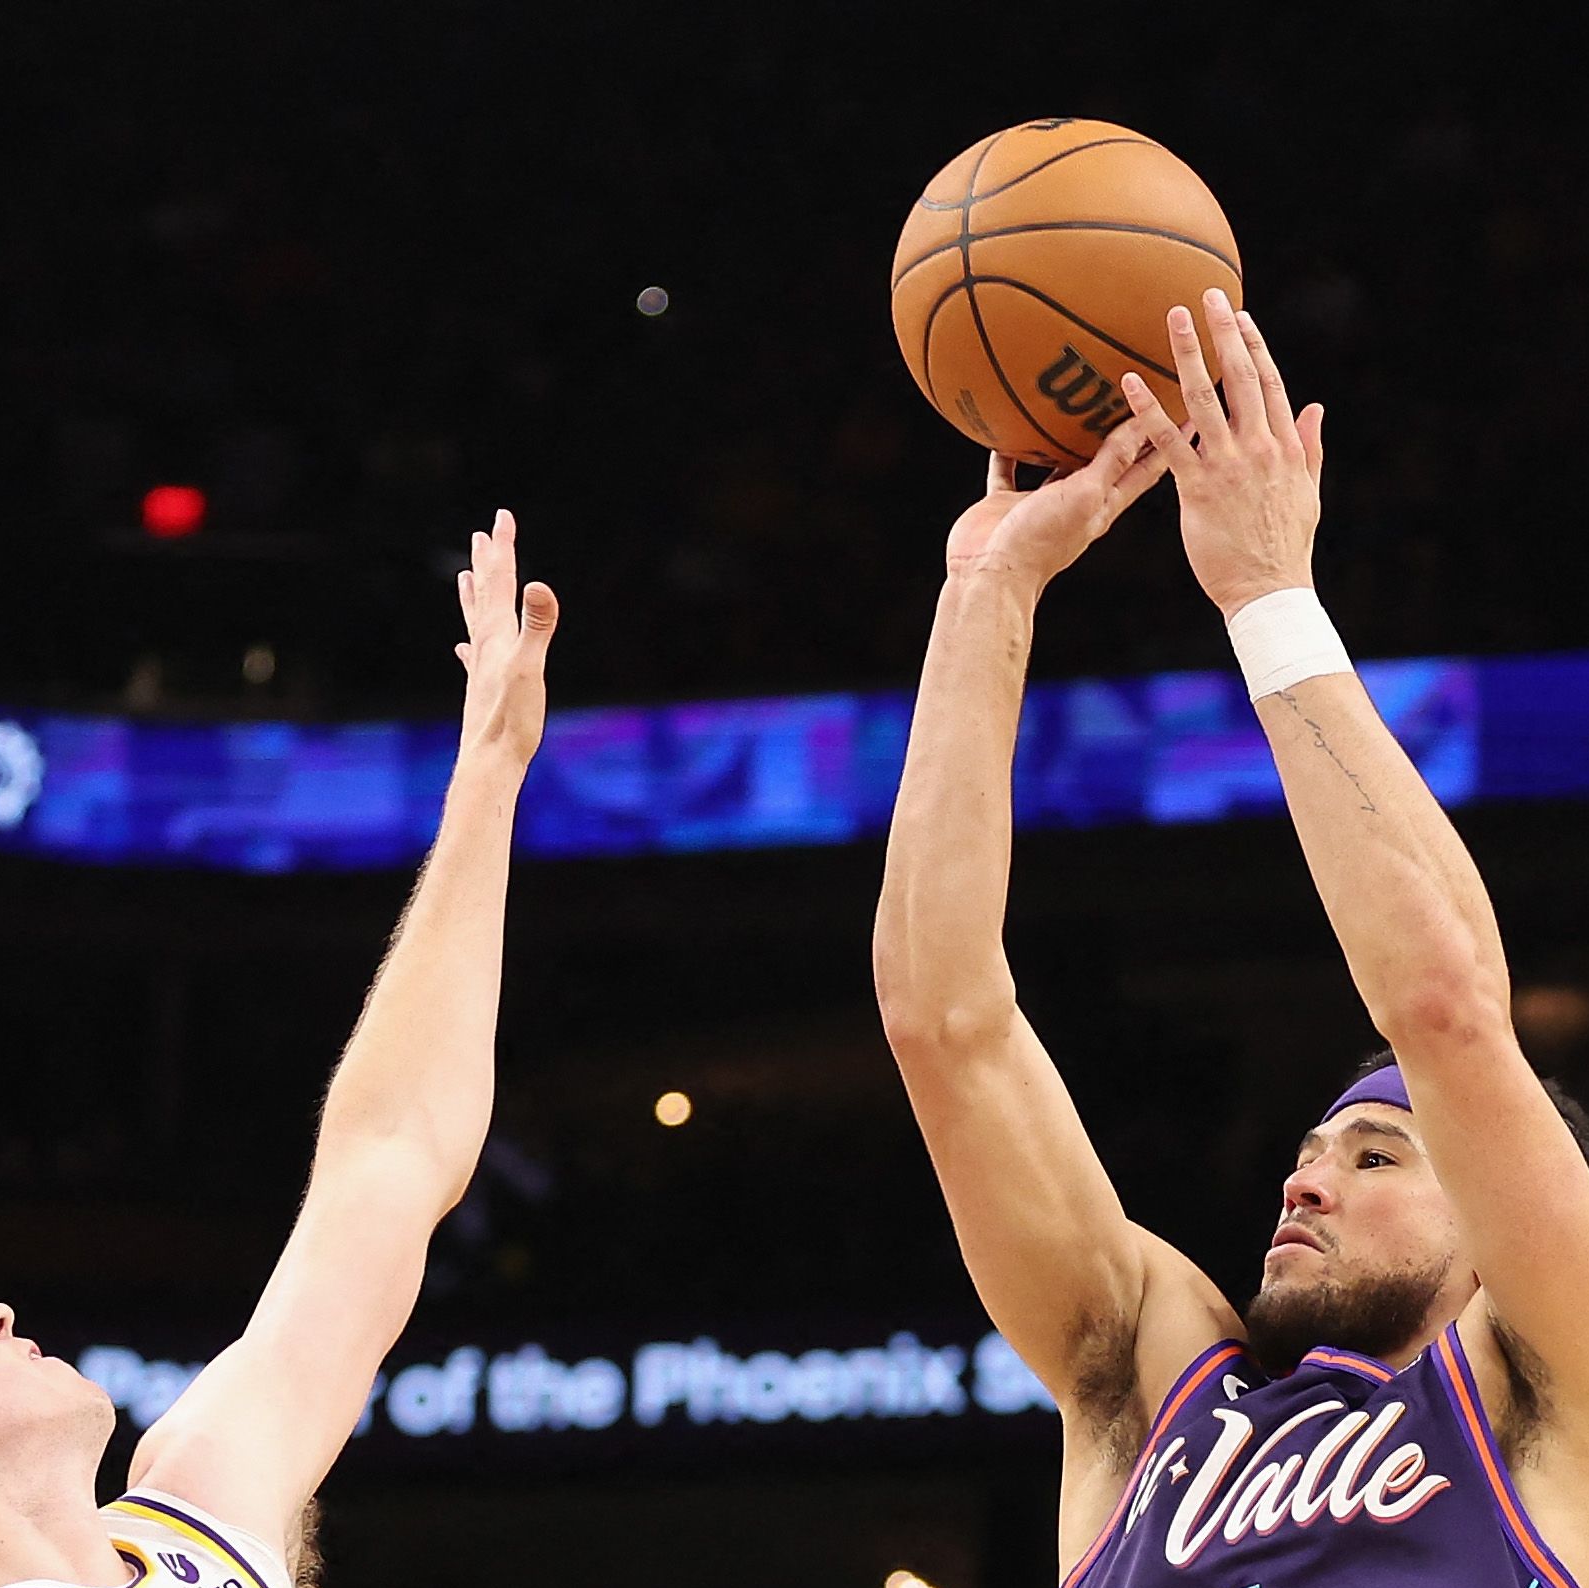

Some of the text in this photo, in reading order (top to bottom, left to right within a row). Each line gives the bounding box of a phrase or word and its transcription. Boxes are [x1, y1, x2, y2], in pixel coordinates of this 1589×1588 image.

[386, 1345, 488, 1438] of
[488, 1342, 628, 1432] the
[632, 1331, 967, 1428] Phoenix
[1165, 1400, 1450, 1568] Valle
